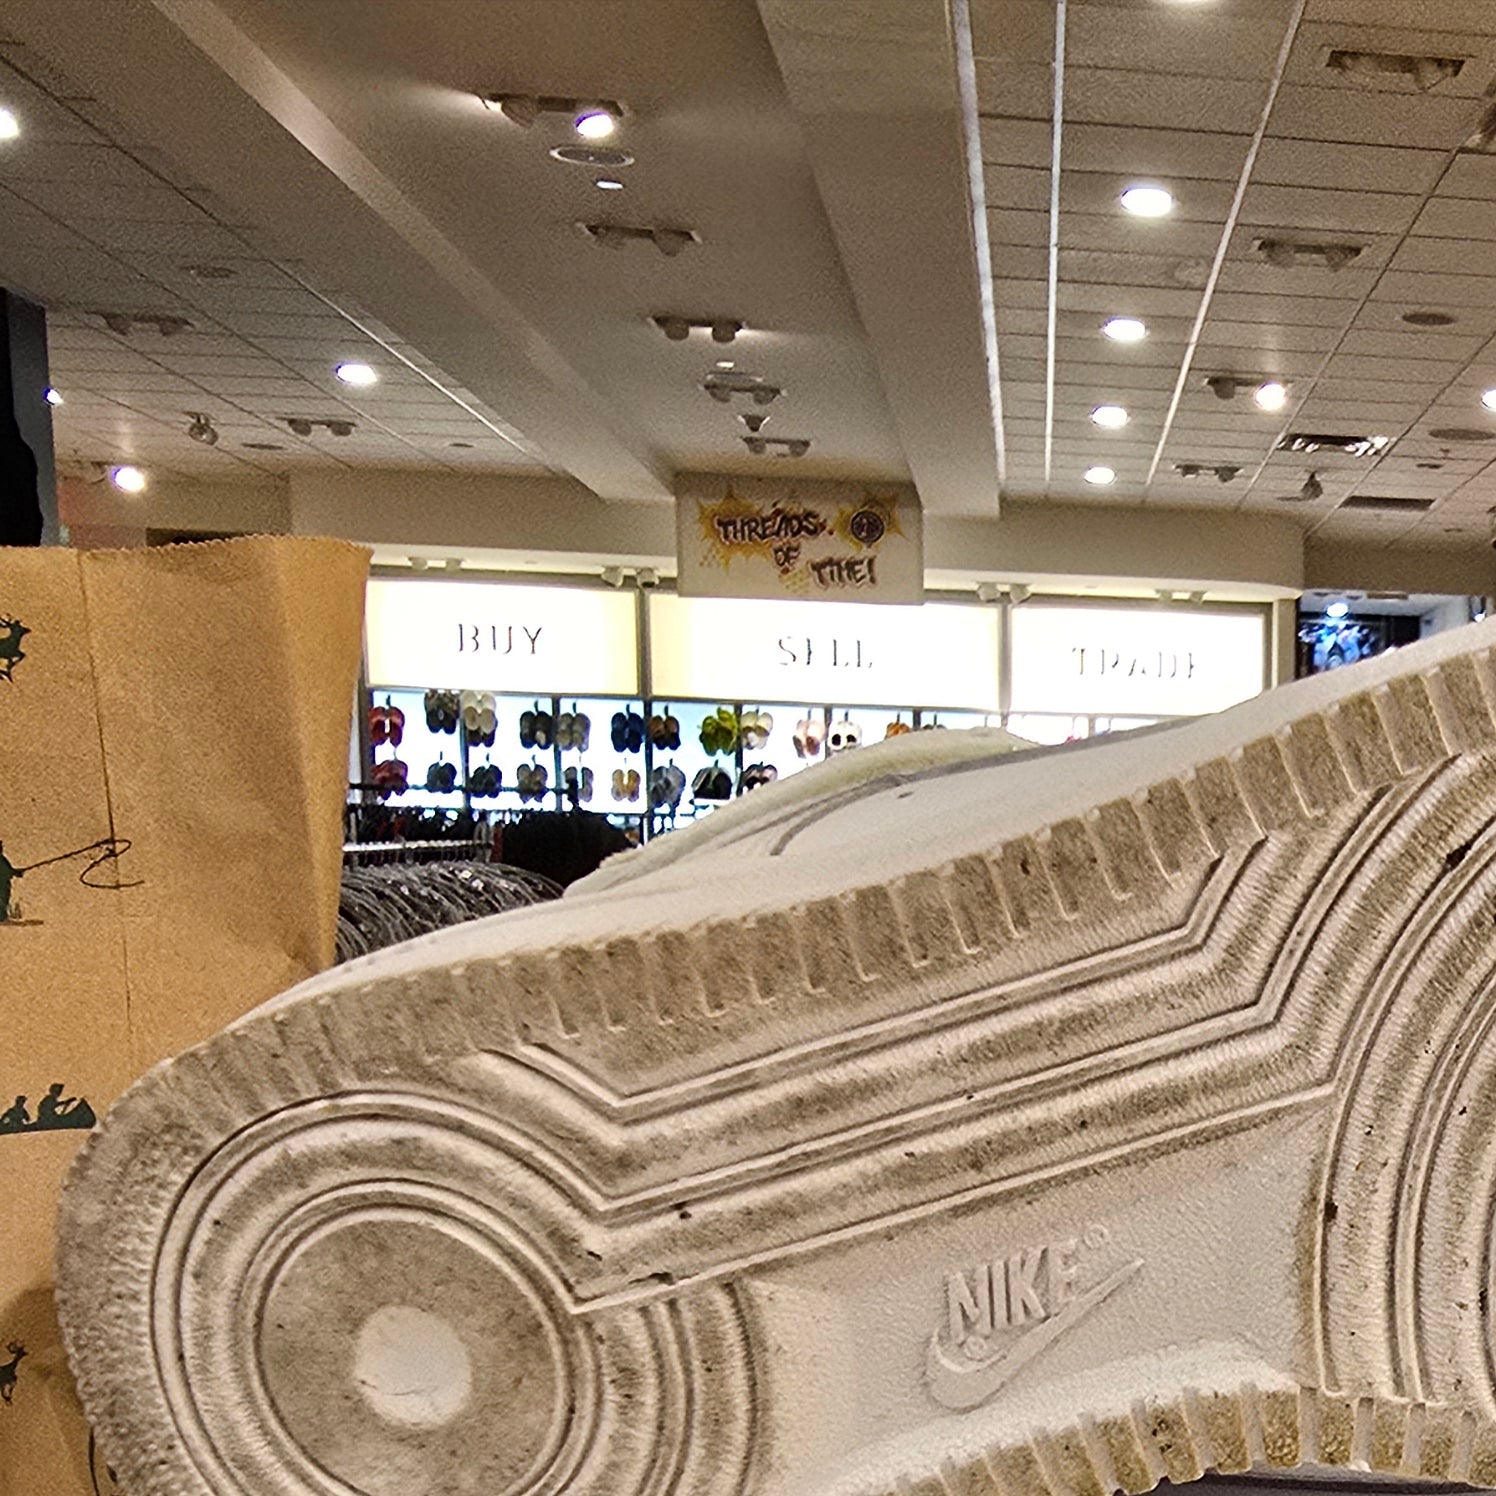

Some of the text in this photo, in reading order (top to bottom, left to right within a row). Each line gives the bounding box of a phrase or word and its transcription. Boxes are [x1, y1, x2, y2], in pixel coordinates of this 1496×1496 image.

[715, 508, 821, 543] THREADS
[772, 547, 800, 567] OF
[457, 622, 543, 655] BUY
[778, 635, 873, 669] SELL
[944, 1237, 1084, 1347] NIKE
